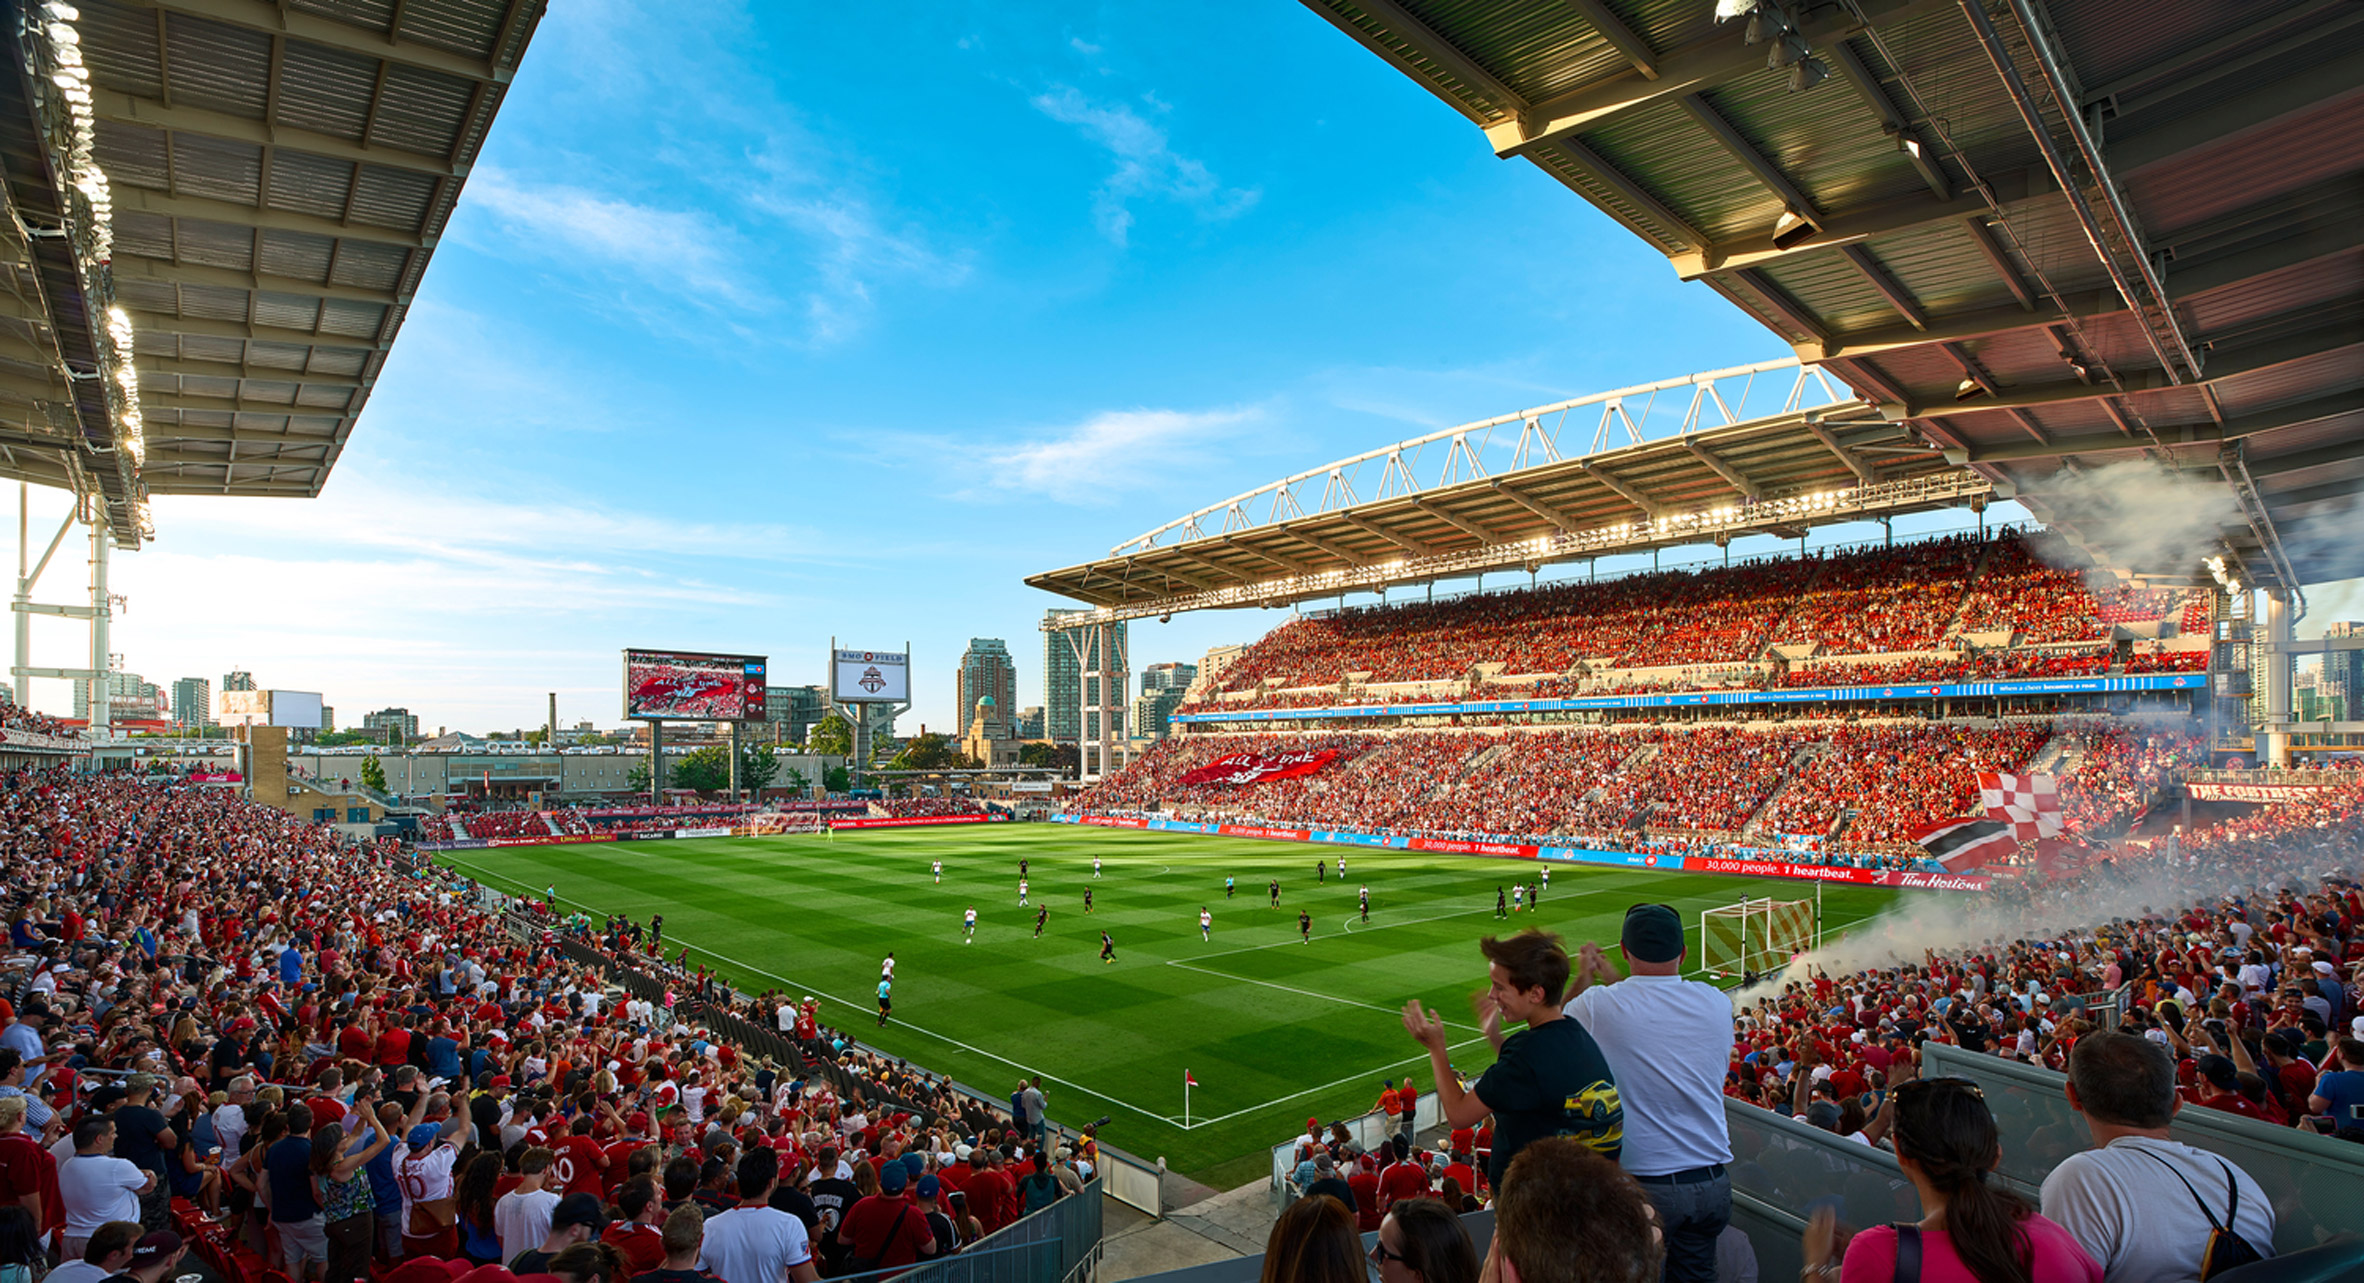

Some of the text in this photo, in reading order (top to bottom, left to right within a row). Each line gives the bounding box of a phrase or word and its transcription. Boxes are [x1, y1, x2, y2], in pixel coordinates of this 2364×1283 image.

[2188, 784, 2222, 799] THE
[2223, 785, 2319, 801] FORTRESS
[1423, 840, 1446, 849] 30,000
[1480, 844, 1520, 855] heartbeat.
[1706, 860, 1855, 879] 30,000 people. 1 heartbeat.
[1901, 872, 1984, 890] Tim Hortons
